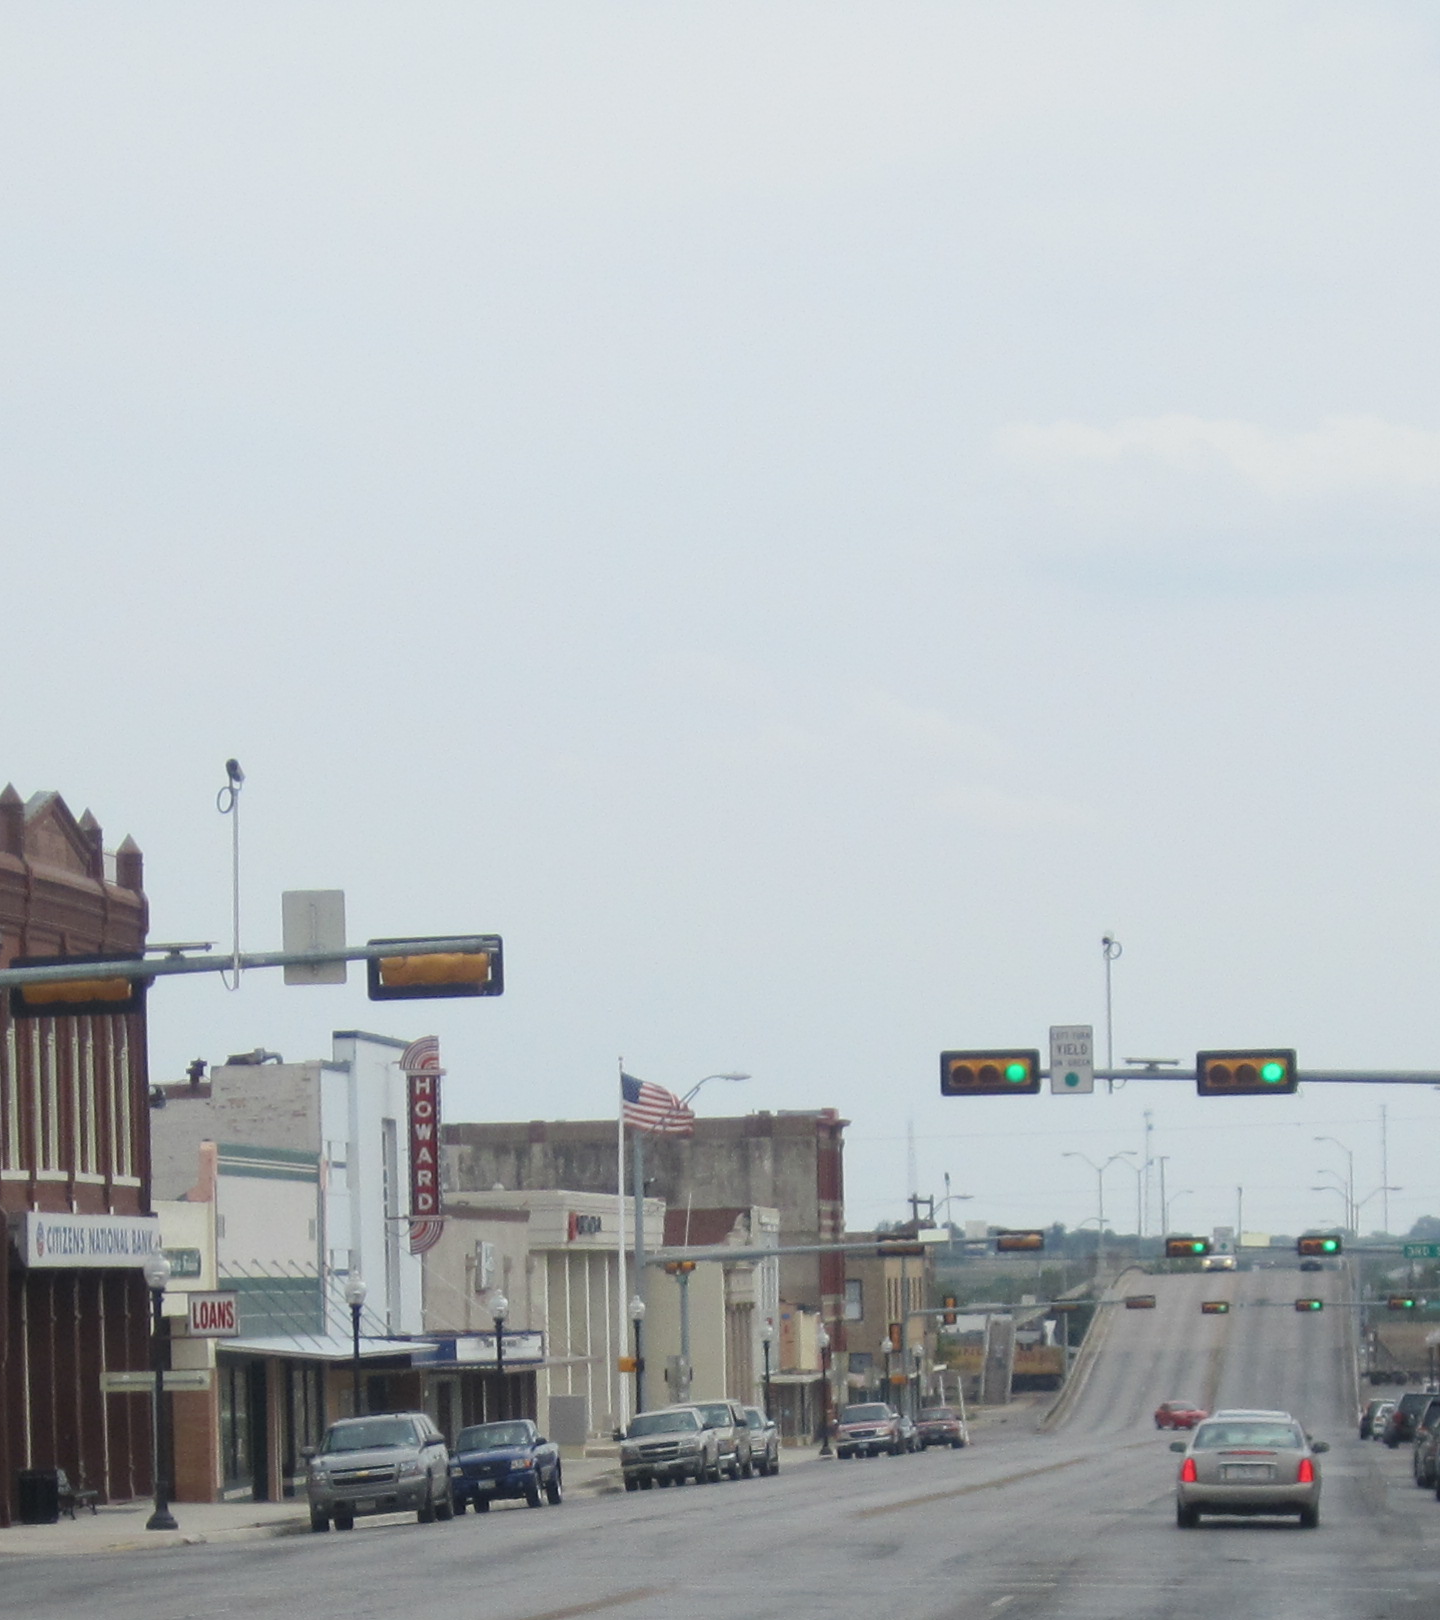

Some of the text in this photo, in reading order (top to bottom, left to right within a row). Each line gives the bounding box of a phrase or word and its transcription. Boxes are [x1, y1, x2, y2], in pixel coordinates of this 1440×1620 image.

[1057, 1043, 1088, 1056] YIELD
[415, 1077, 433, 1210] HOWARD
[47, 1226, 85, 1254] CITIZENS
[89, 1227, 129, 1254] NATIONAL
[192, 1301, 234, 1329] LOANS
